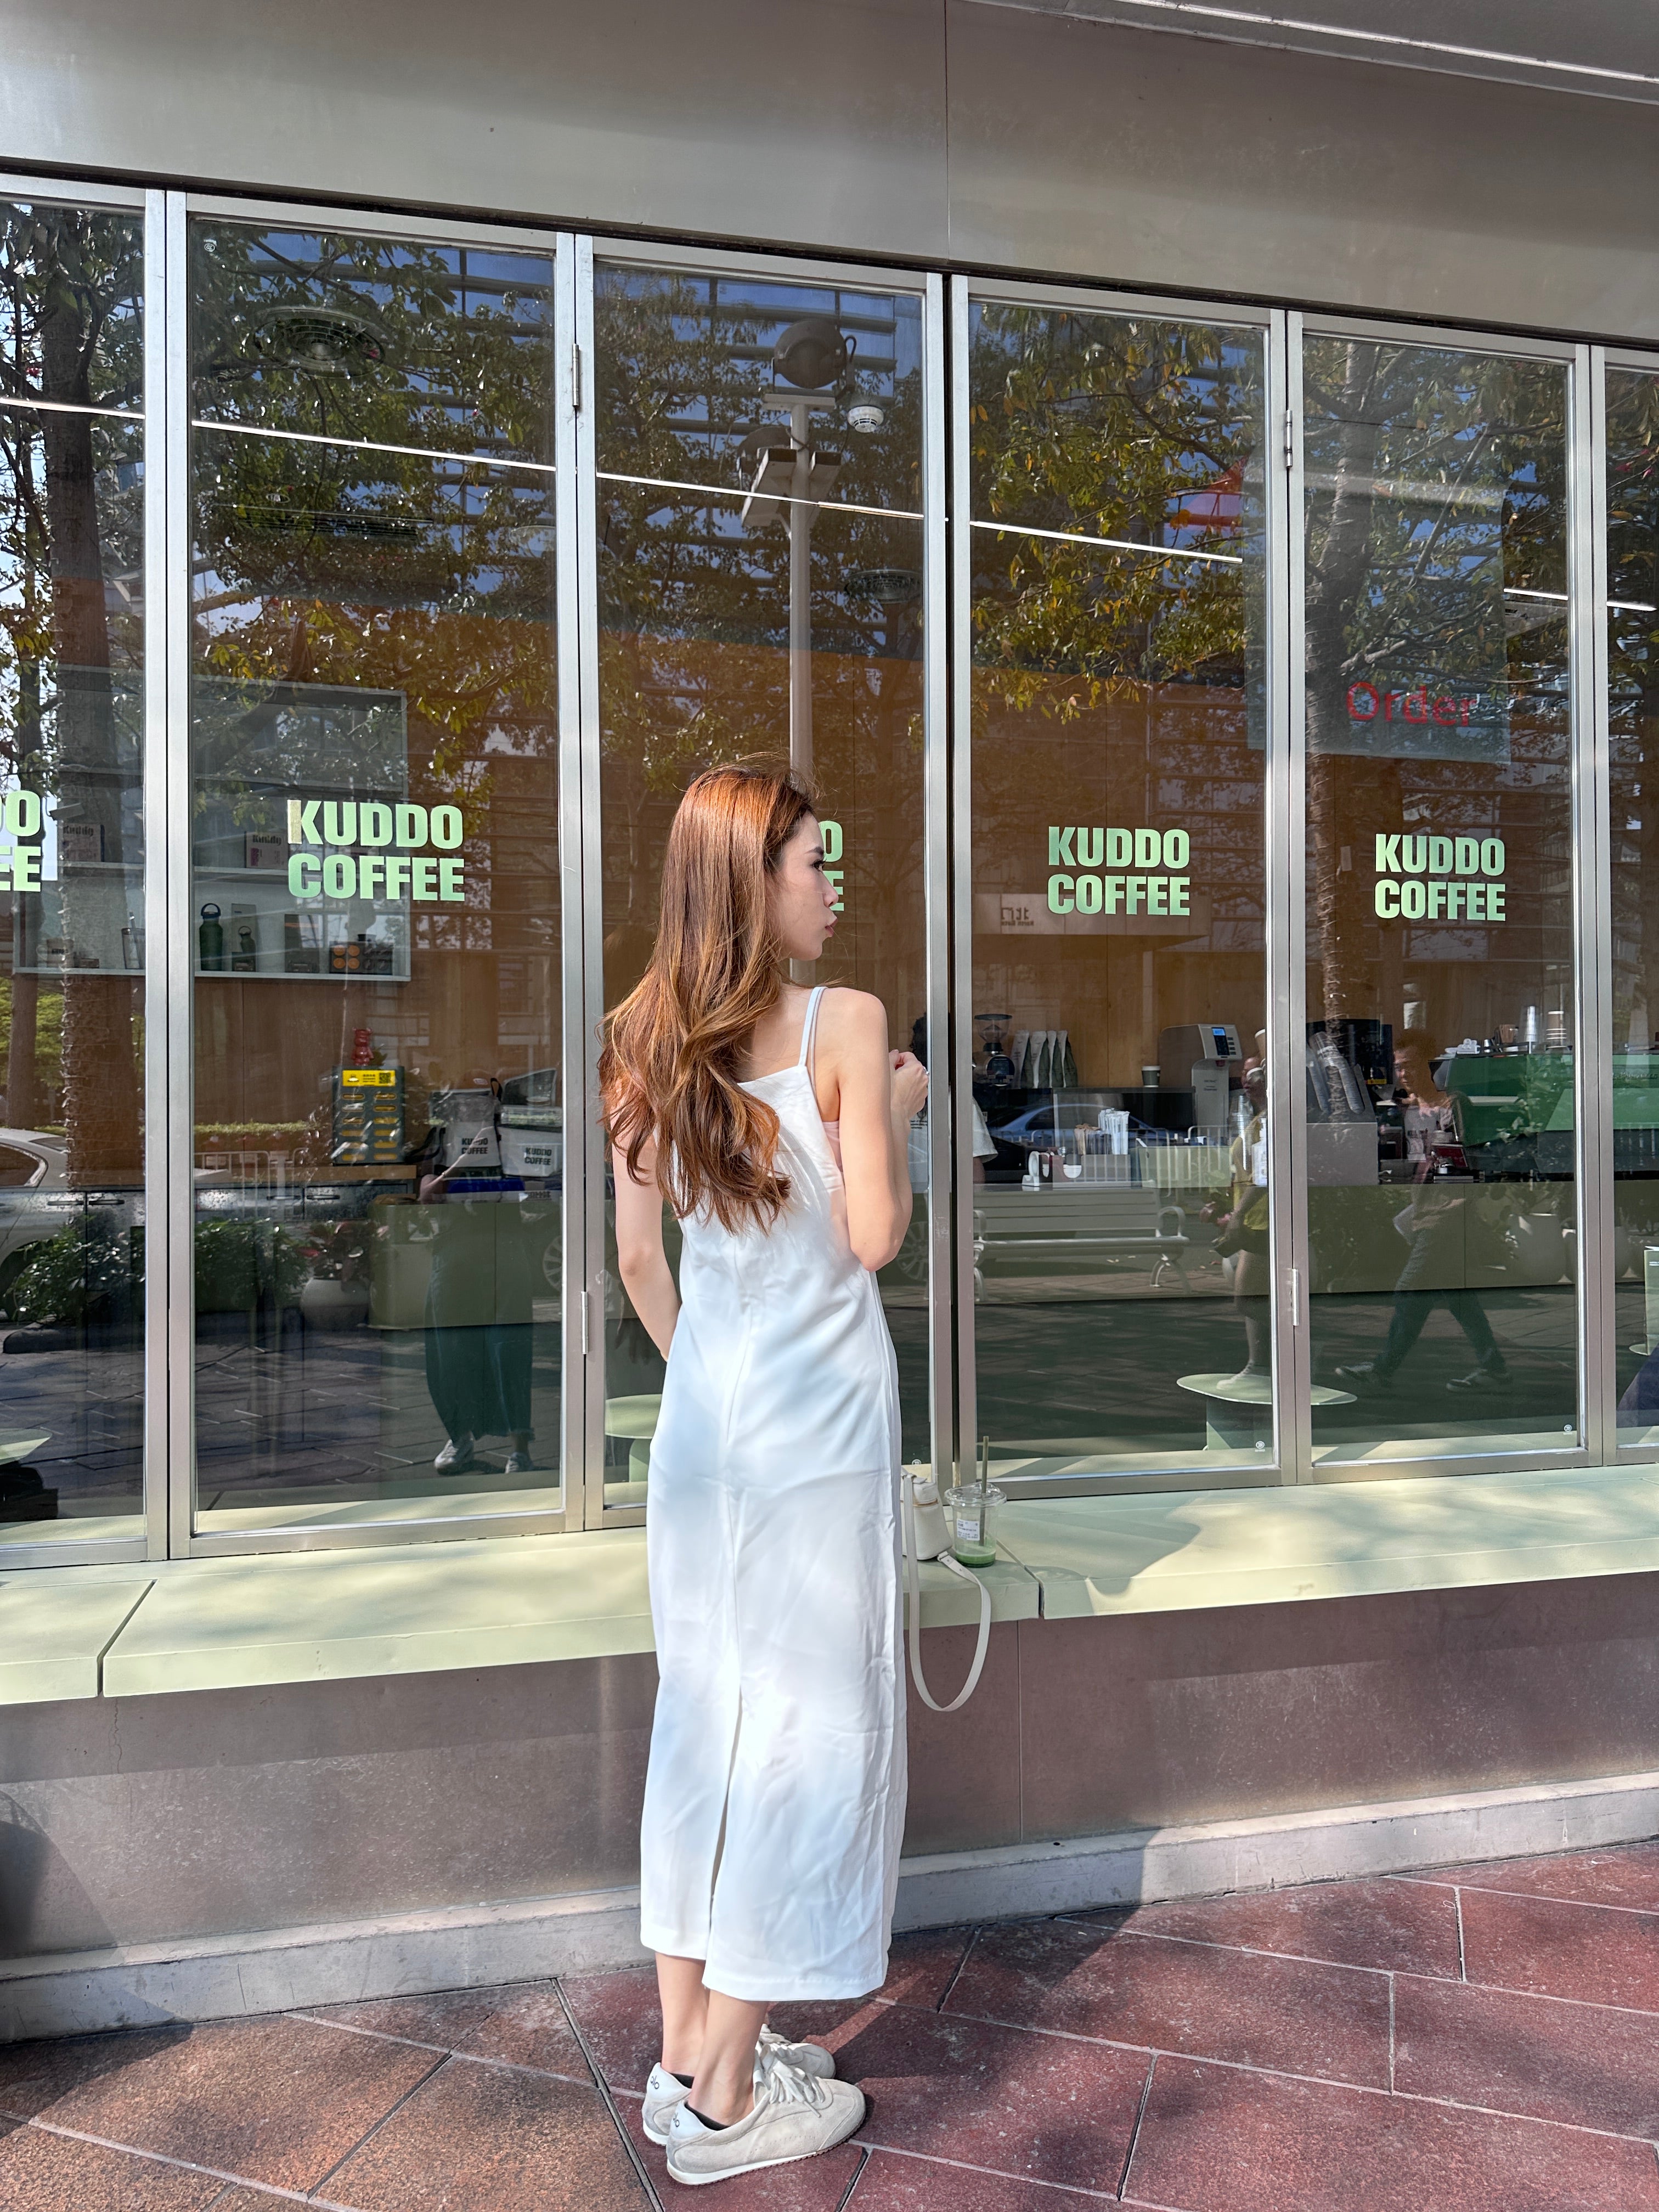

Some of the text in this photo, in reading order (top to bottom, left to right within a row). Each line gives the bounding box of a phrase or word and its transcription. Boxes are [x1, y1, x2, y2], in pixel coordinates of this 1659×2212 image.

[1346, 681, 1477, 726] Order
[287, 799, 463, 849] KUDDO
[1048, 826, 1190, 868] KUDDO
[1375, 833, 1505, 876] KUDDO
[288, 853, 465, 901] COFFEE
[1048, 874, 1190, 916] COFFEE
[1375, 879, 1505, 921] COFFEE
[524, 1156, 551, 1165] COFFEE
[526, 1147, 552, 1156] KUDDO
[650, 2075, 660, 2090] alo
